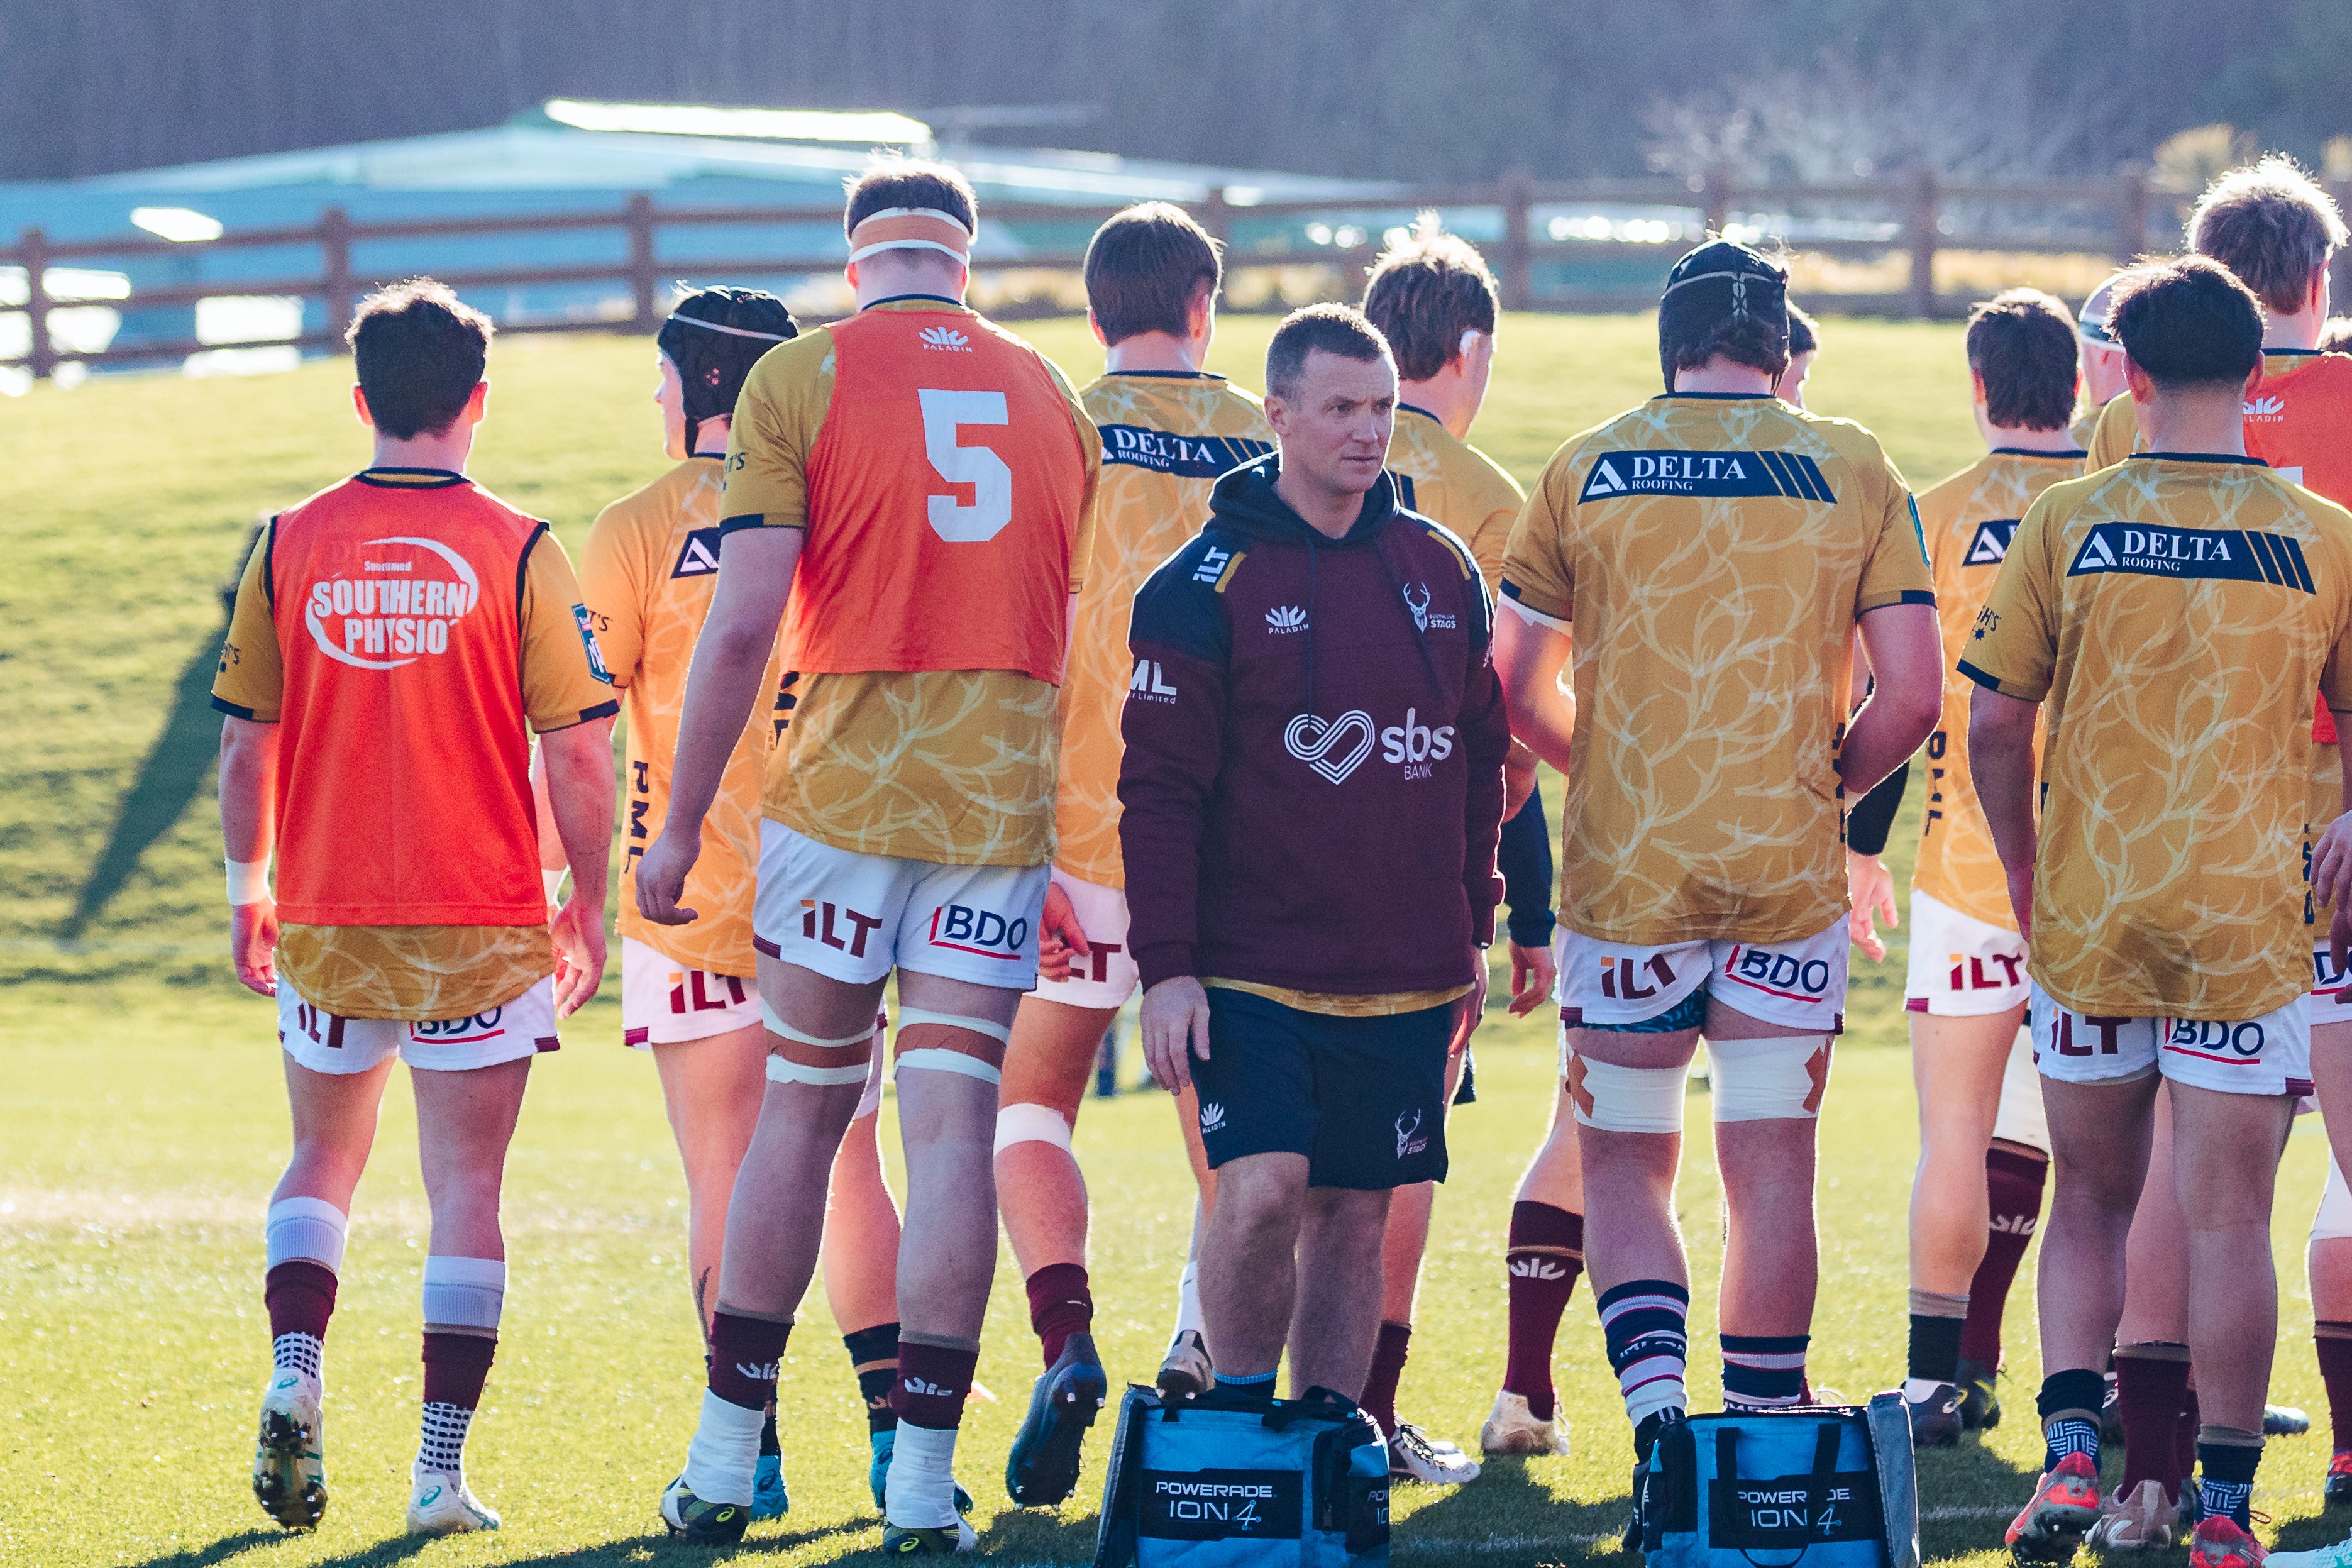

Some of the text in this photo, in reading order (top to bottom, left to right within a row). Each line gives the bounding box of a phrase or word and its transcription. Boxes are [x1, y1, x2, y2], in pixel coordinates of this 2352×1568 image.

[922, 343, 973, 353] PALADIN
[2244, 415, 2284, 423] LADIN
[1113, 429, 1216, 464] DELTA
[918, 389, 1012, 542] 5
[1117, 450, 1169, 468] ROOFING
[1631, 456, 1747, 480] DELTA
[1631, 480, 1693, 490] ROOFING
[2122, 530, 2232, 561] DELTA
[2122, 556, 2180, 571] ROOFING
[313, 579, 468, 617] SOUTHERN
[1269, 624, 1309, 634] PALADIN
[1430, 619, 1456, 629] STAGS
[344, 618, 448, 654] PHYSIO
[1130, 659, 1177, 696] ML
[1138, 693, 1176, 704] Limited
[1381, 707, 1455, 763] sbs
[1404, 763, 1432, 780] BANK
[944, 904, 1027, 951] BDO
[1740, 950, 1828, 993] BDO
[2171, 1016, 2265, 1056] BDO
[1202, 1120, 1226, 1134] PALADIN
[1156, 1481, 1273, 1498] POWERADE
[1737, 1488, 1850, 1504] POWERDE
